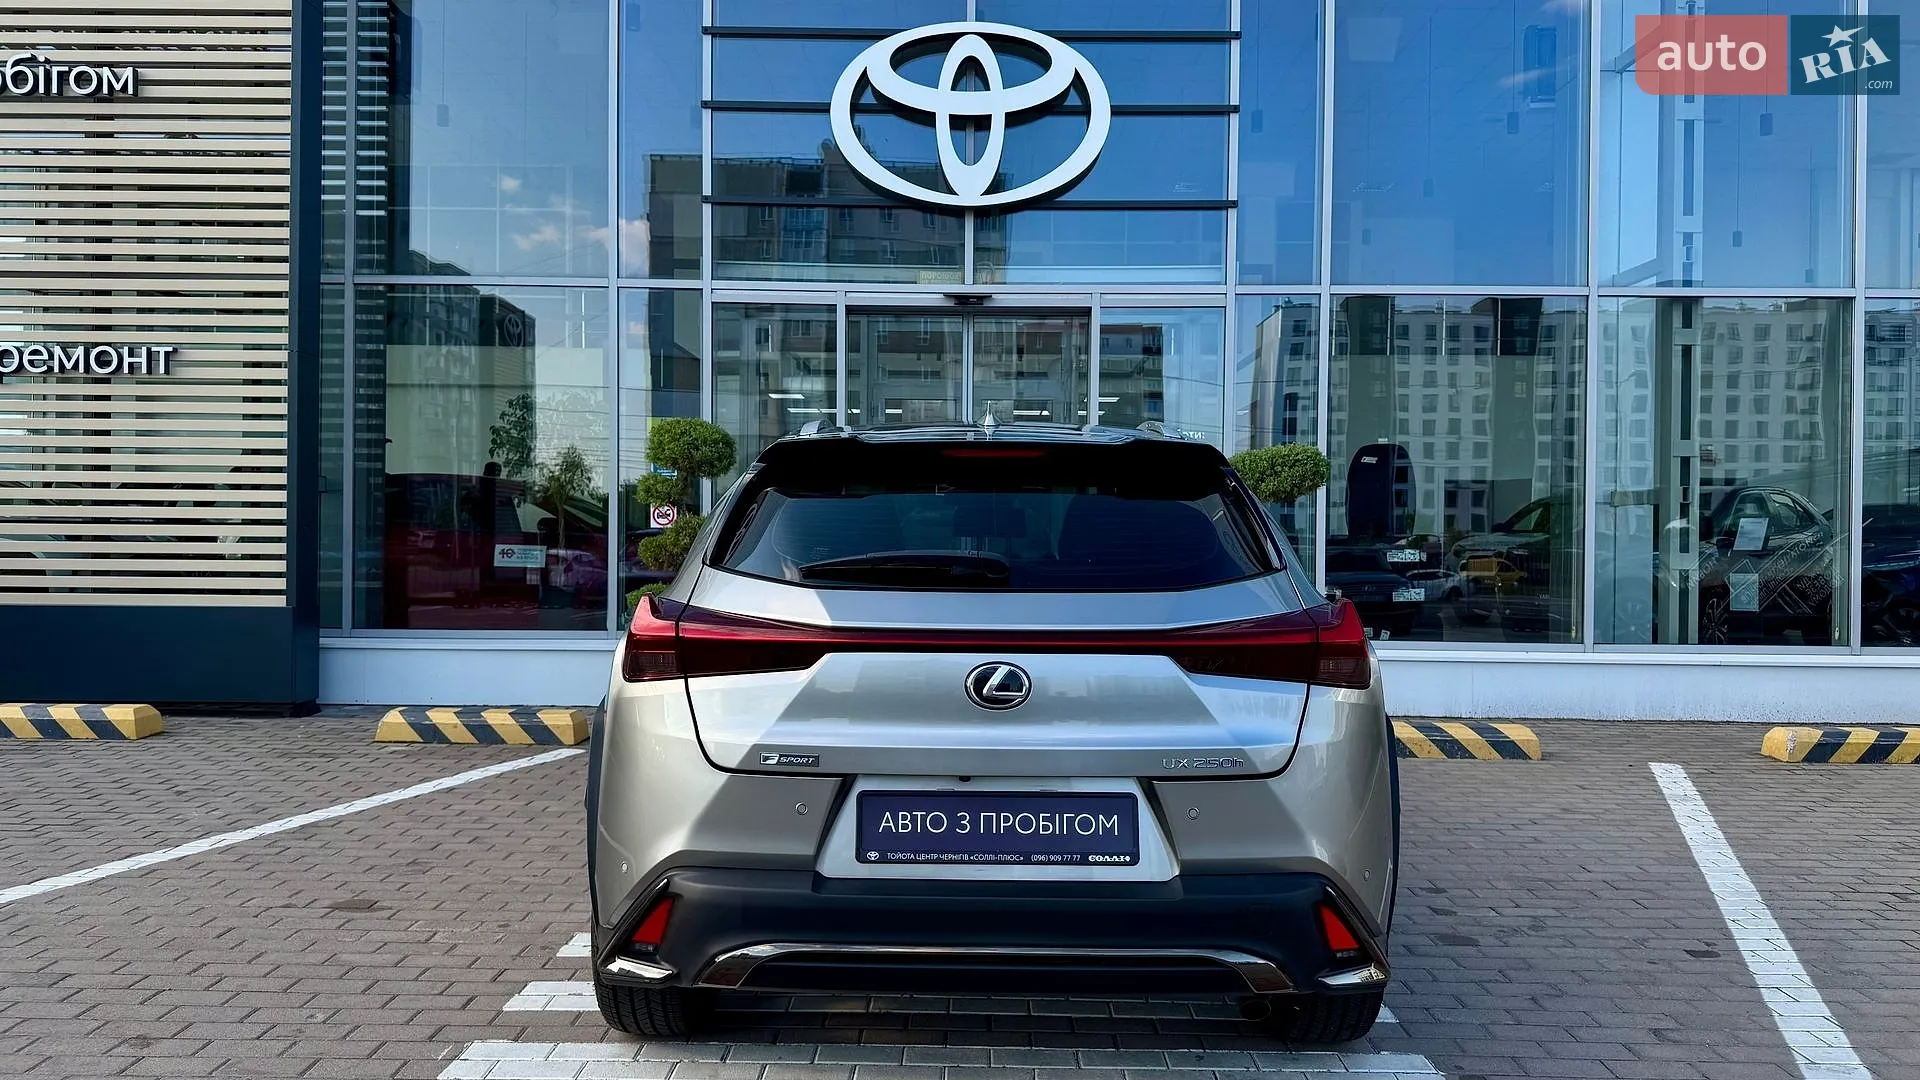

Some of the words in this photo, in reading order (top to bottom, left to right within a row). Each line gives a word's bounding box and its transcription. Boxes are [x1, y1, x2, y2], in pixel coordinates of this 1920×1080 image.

[0, 52, 135, 96] бігом
[780, 756, 816, 764] SPORT
[1162, 758, 1189, 769] UX
[1193, 757, 1244, 769] 250h
[879, 811, 948, 833] АВТО
[956, 812, 971, 834] З
[980, 812, 1118, 836] ПРОБІГОМ
[887, 852, 915, 860] ТОЙОТА
[916, 853, 938, 861] ЦЕНТР
[939, 853, 969, 861] ЧЕРНІГІВ
[1031, 854, 1048, 862] (096)
